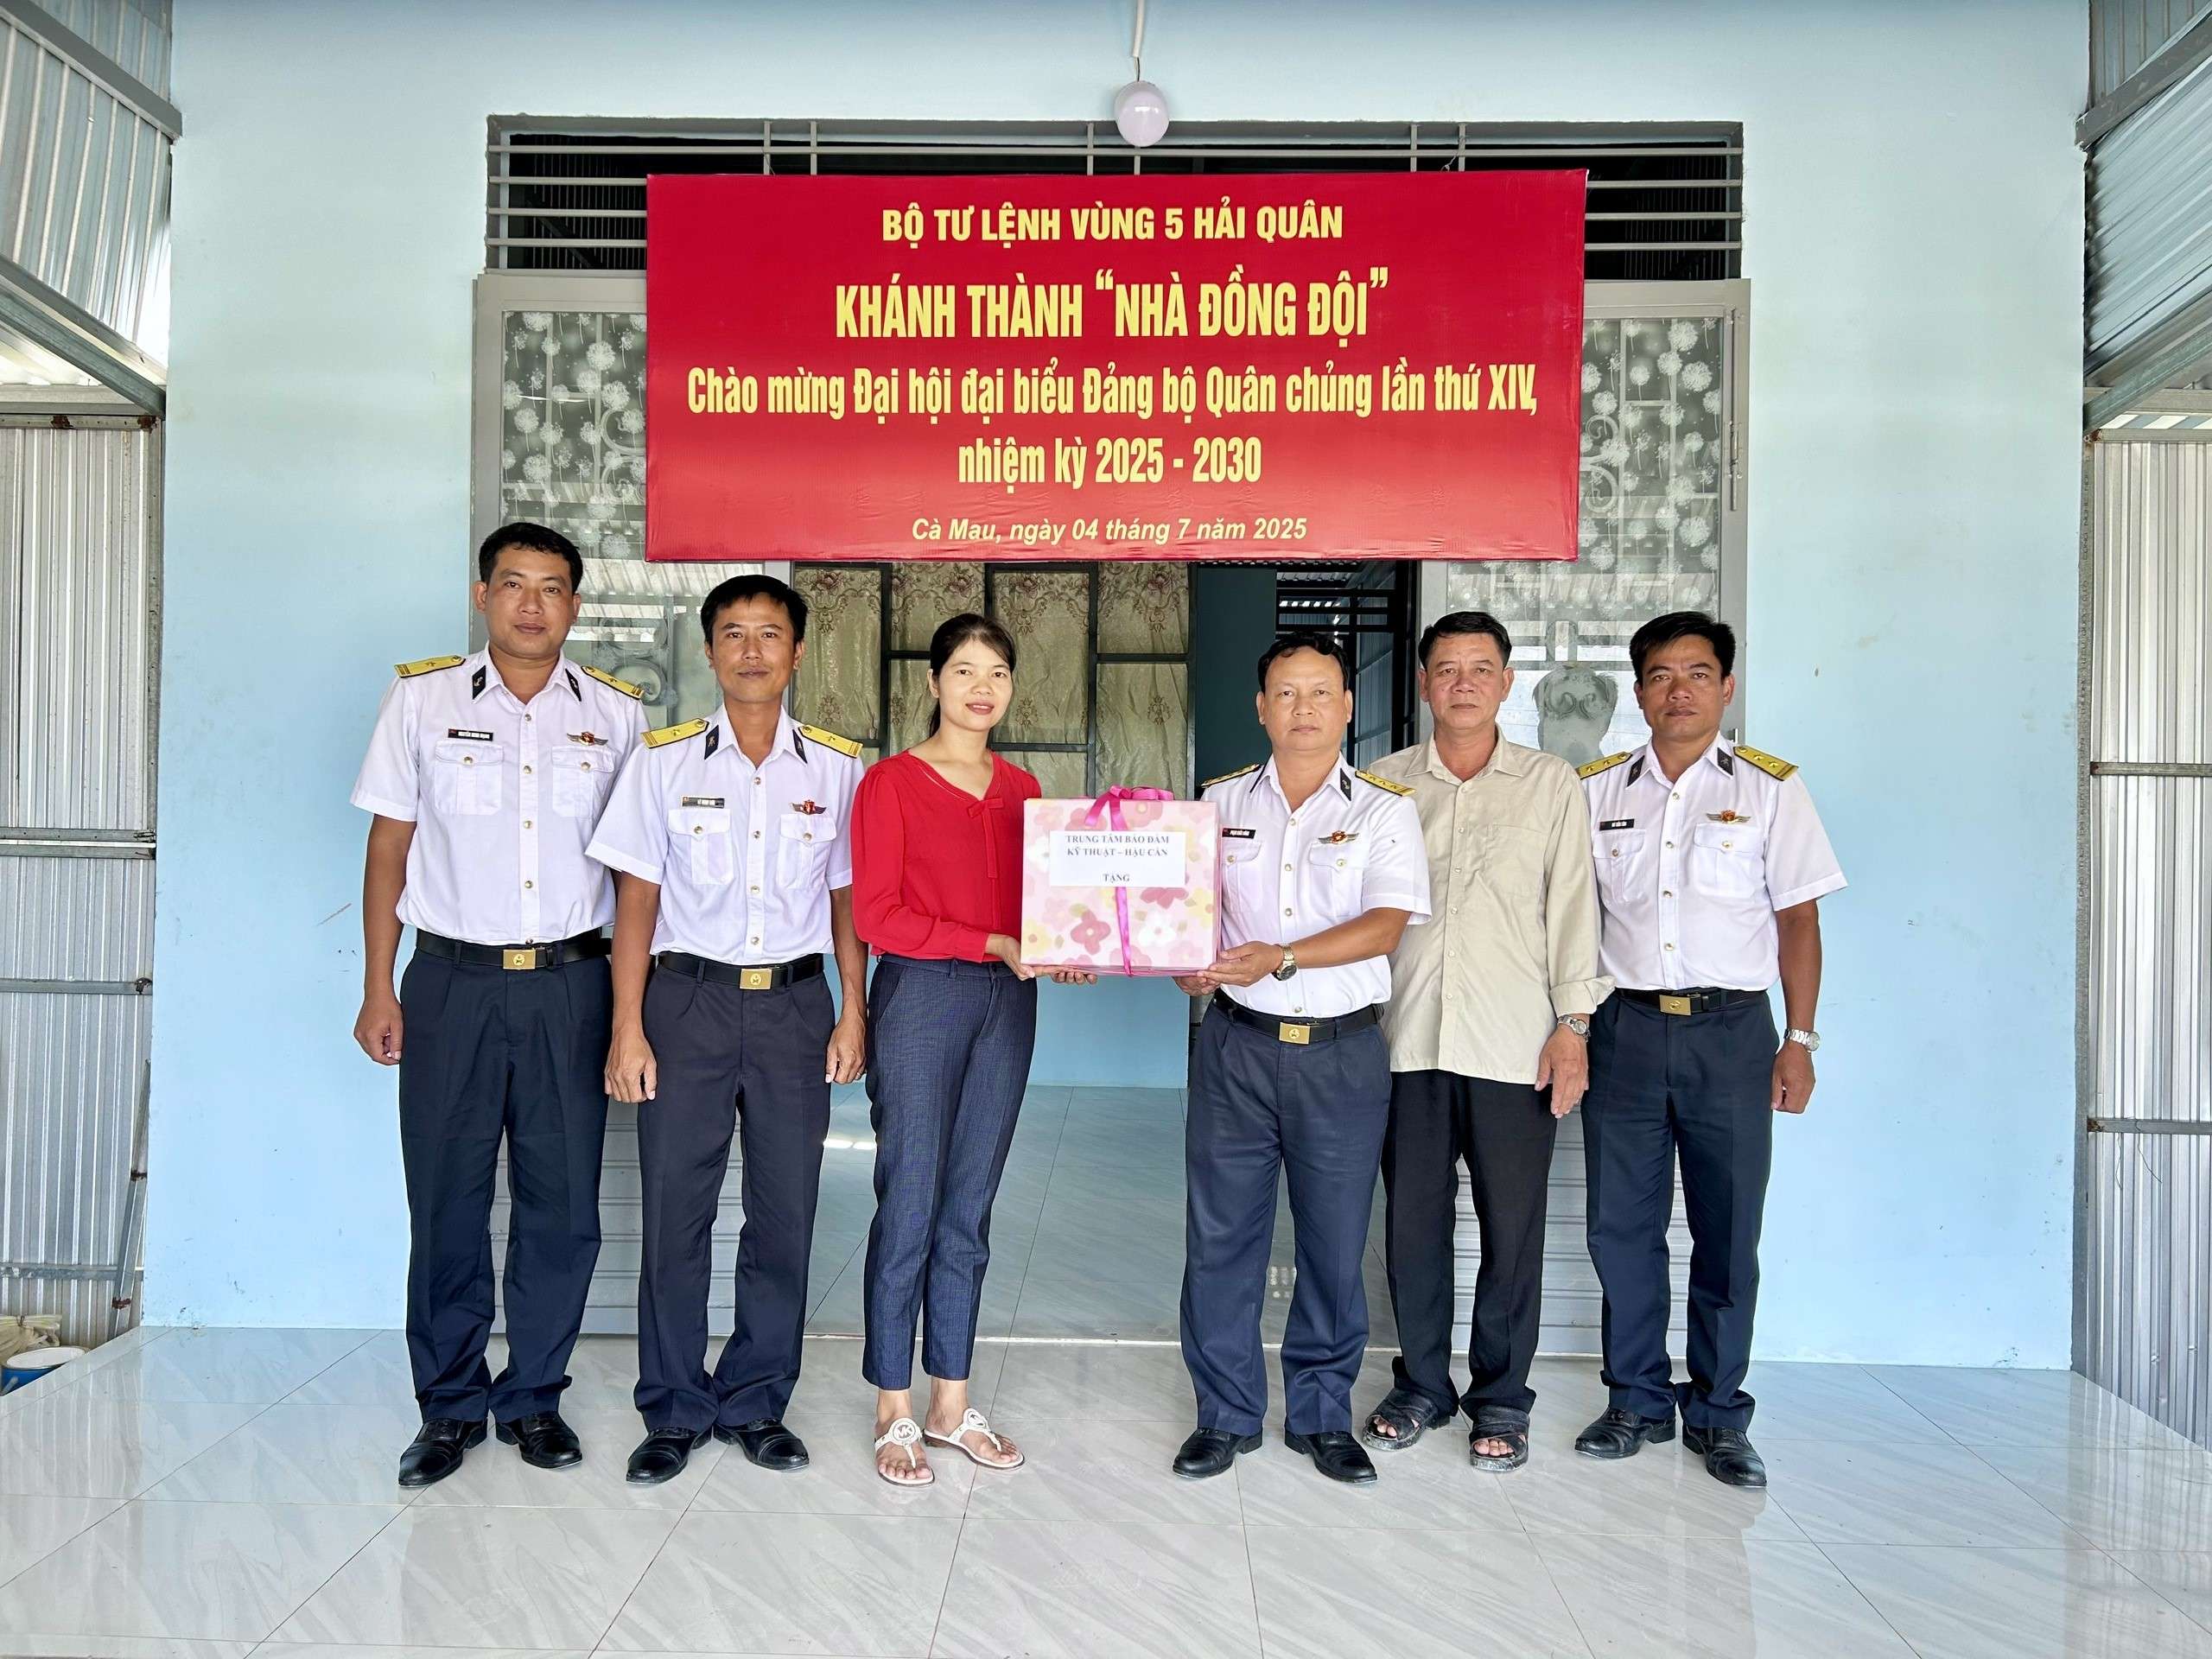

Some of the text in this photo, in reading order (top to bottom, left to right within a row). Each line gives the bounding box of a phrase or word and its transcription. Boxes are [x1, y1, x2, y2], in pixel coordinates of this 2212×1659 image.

[883, 196, 1343, 248] BỘ TƯ LỆNH VÙNG 5 HẢI QUÂN
[836, 264, 1389, 348] KHÁNH THÀNH “NHÀ ĐỒNG ĐỘI”
[689, 357, 1537, 424] Chào mừng Đại hội đại biểu Đảng bộ Quân chủng lần thứ XIV,
[959, 436, 1046, 493] nhiệm
[1055, 436, 1088, 489] kỳ
[1096, 438, 1164, 483] 2025
[1192, 436, 1262, 483] 2030
[912, 518, 1307, 545] Cà Mau, ngày 04 tháng 7 năm 2025
[1065, 835, 1099, 844] TRUNG
